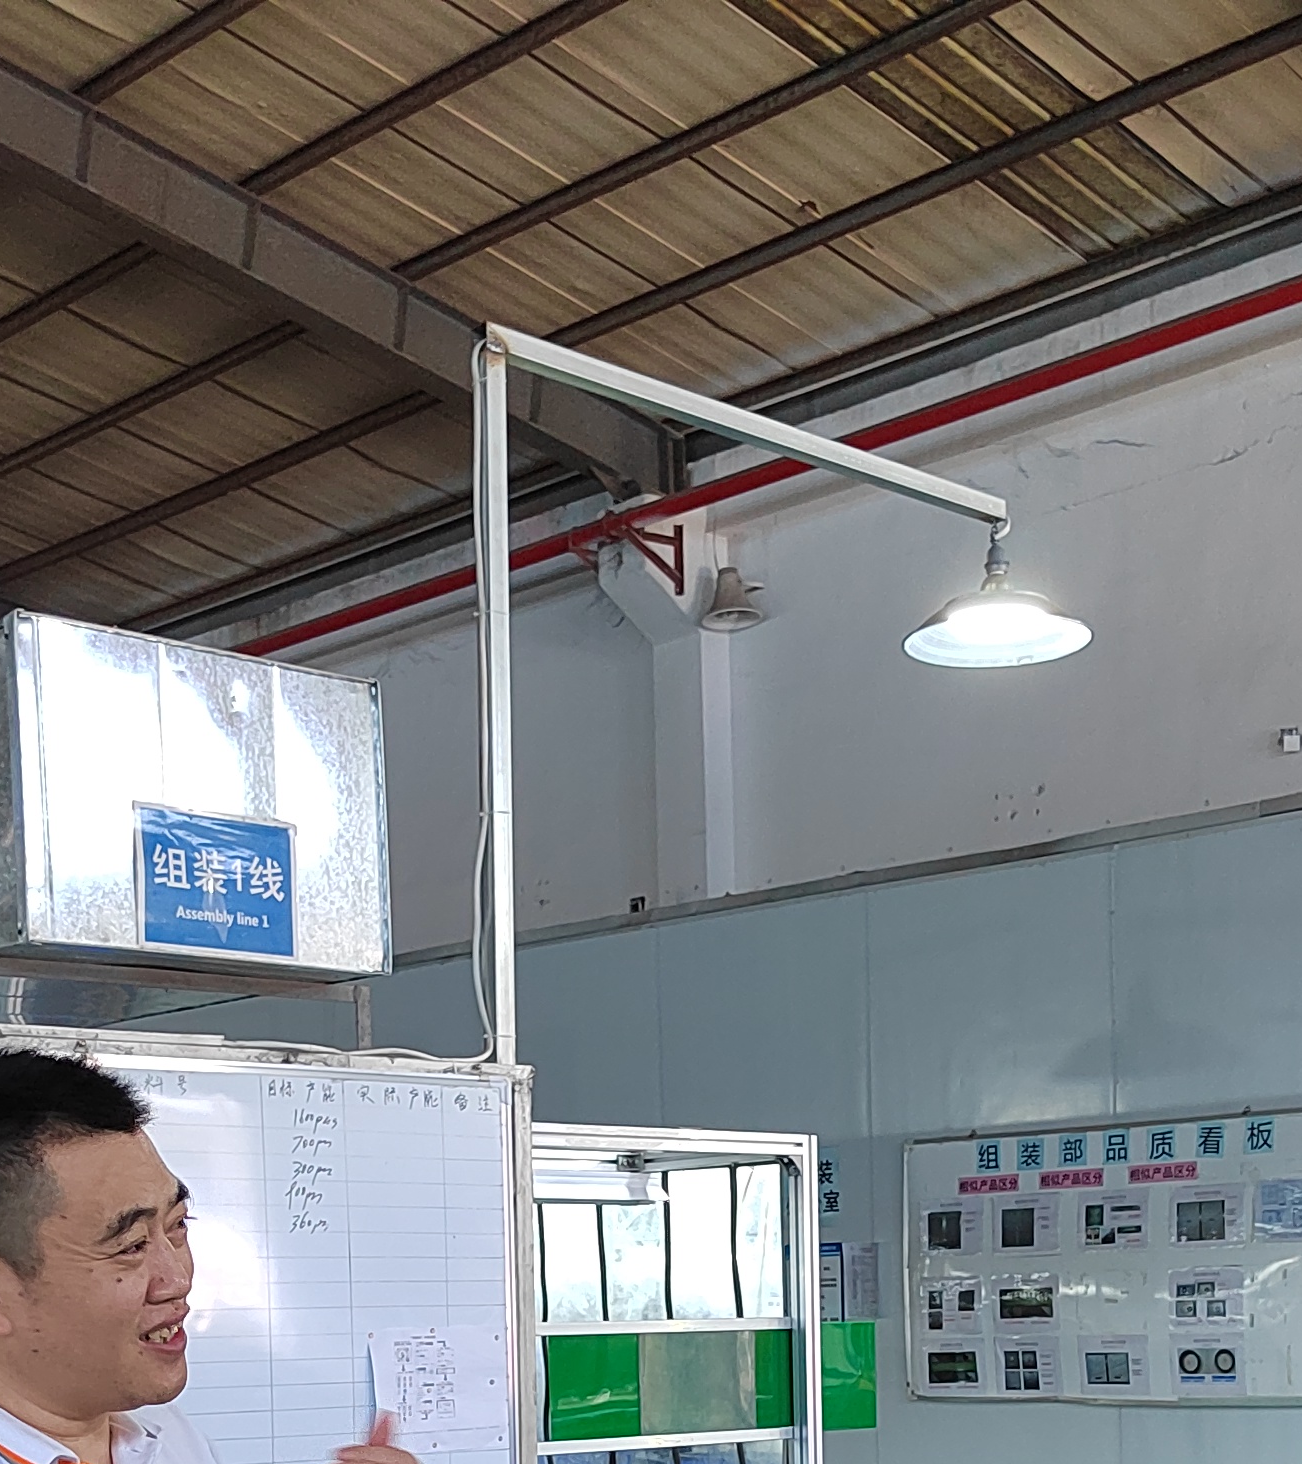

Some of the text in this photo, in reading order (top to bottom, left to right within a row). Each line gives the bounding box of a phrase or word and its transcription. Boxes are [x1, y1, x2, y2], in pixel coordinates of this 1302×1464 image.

[152, 843, 285, 902] 组装1线
[176, 905, 270, 928] Assembly line 1
[268, 1079, 336, 1102] 目标产能
[357, 1085, 439, 1110] 实际产能
[454, 1092, 492, 1112] 备注
[978, 1120, 1273, 1170] 组装部品质看板
[823, 1190, 840, 1213] 室
